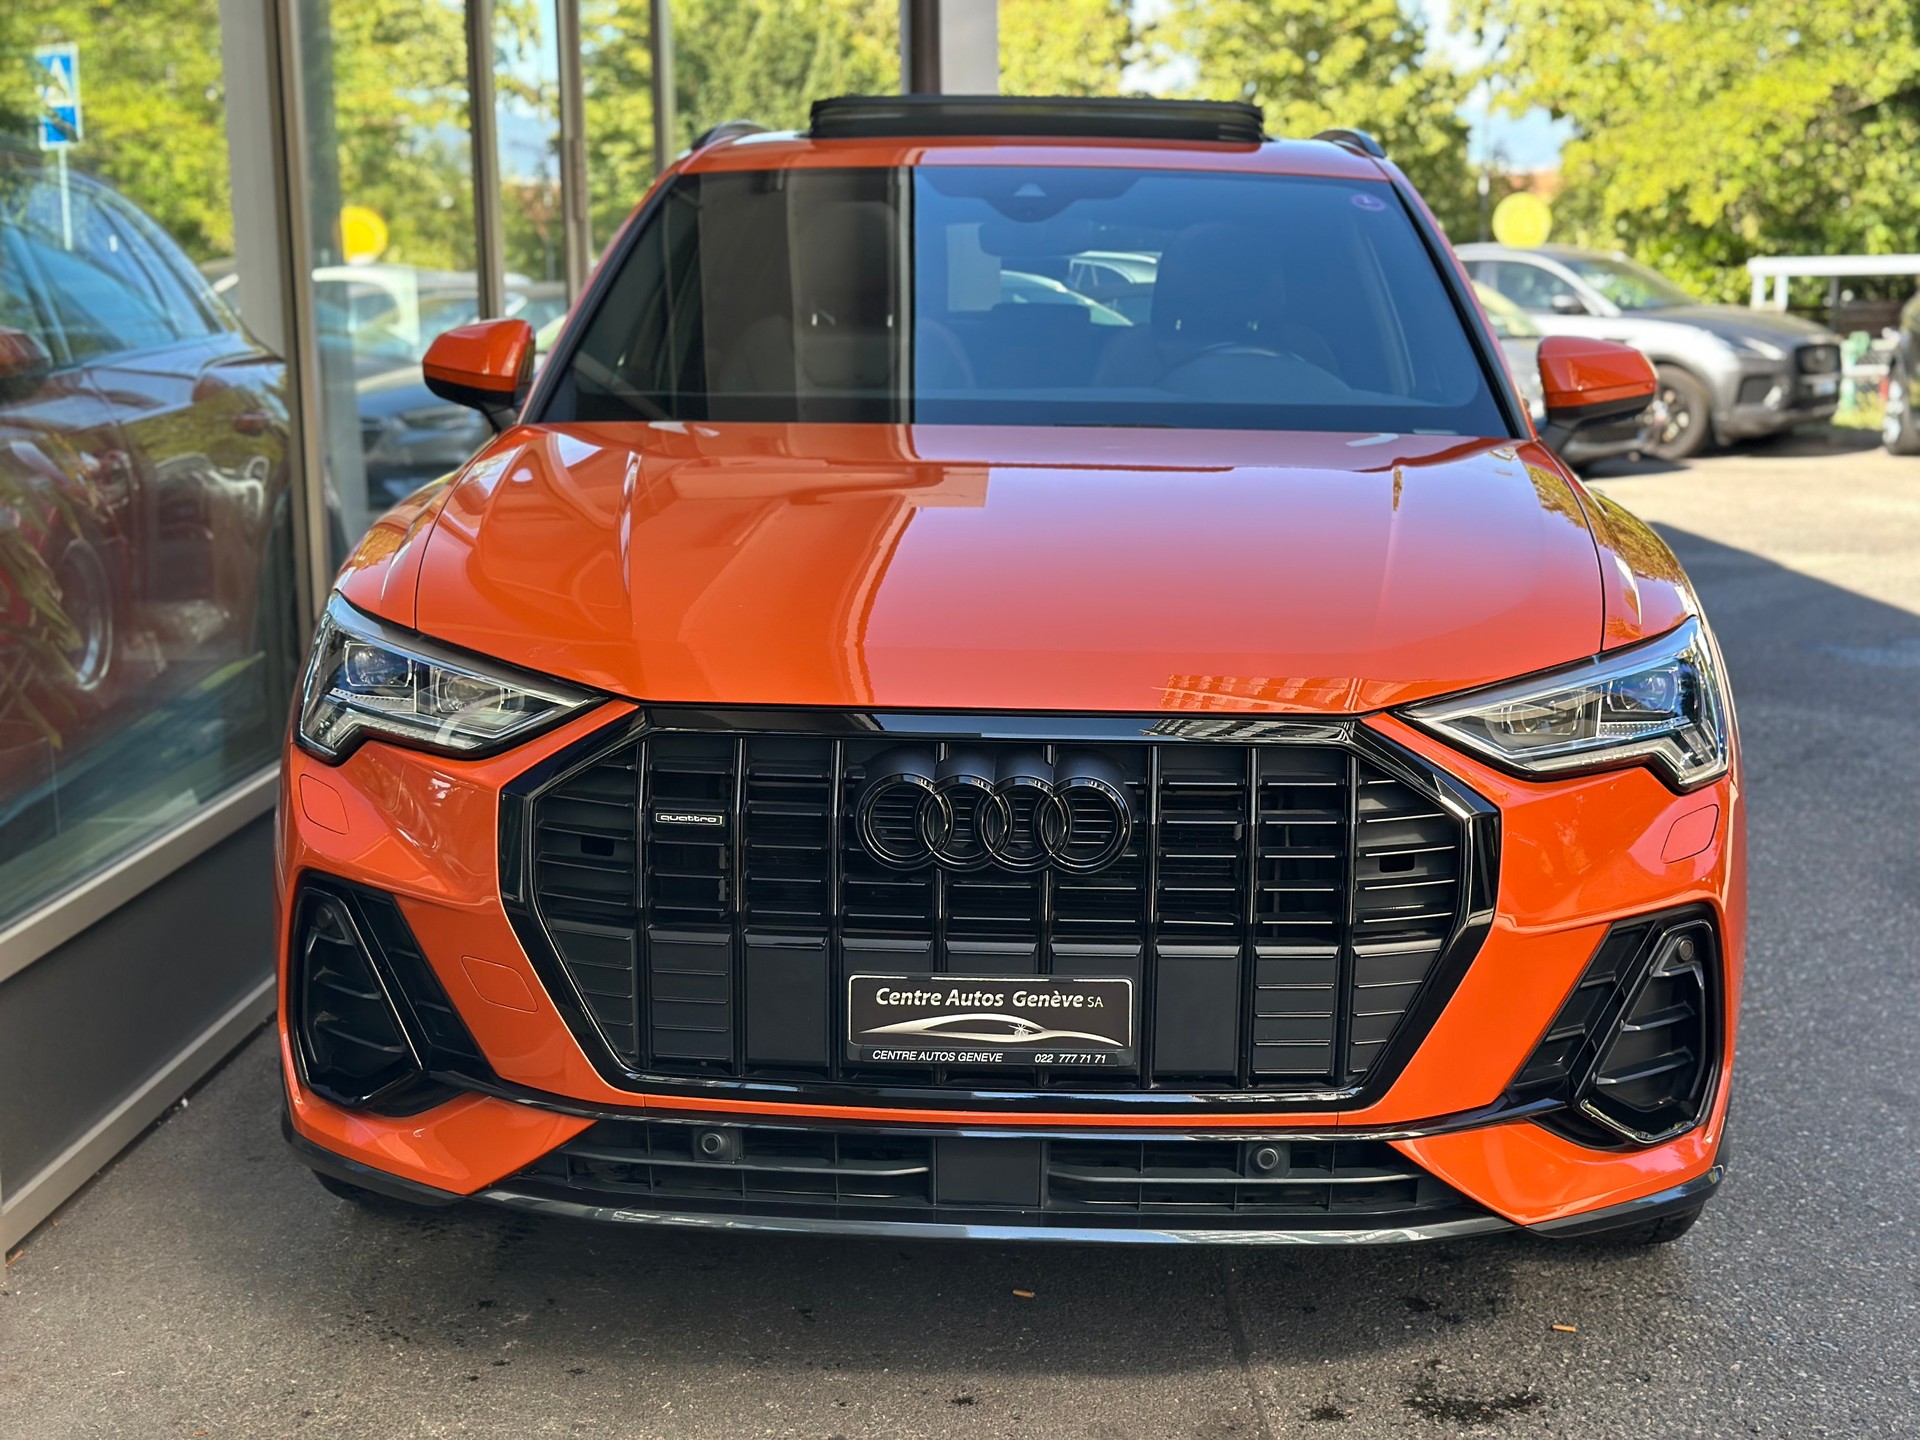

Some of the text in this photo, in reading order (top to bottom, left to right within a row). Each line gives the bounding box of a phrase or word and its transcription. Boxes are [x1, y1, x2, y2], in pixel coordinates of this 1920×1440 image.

[660, 814, 717, 823] quattro
[876, 987, 1104, 1008] Centre Autos Genève SA
[872, 1050, 1004, 1063] CENTRE AUTOS GENEVE
[1034, 1053, 1106, 1064] 022 777 71 71
